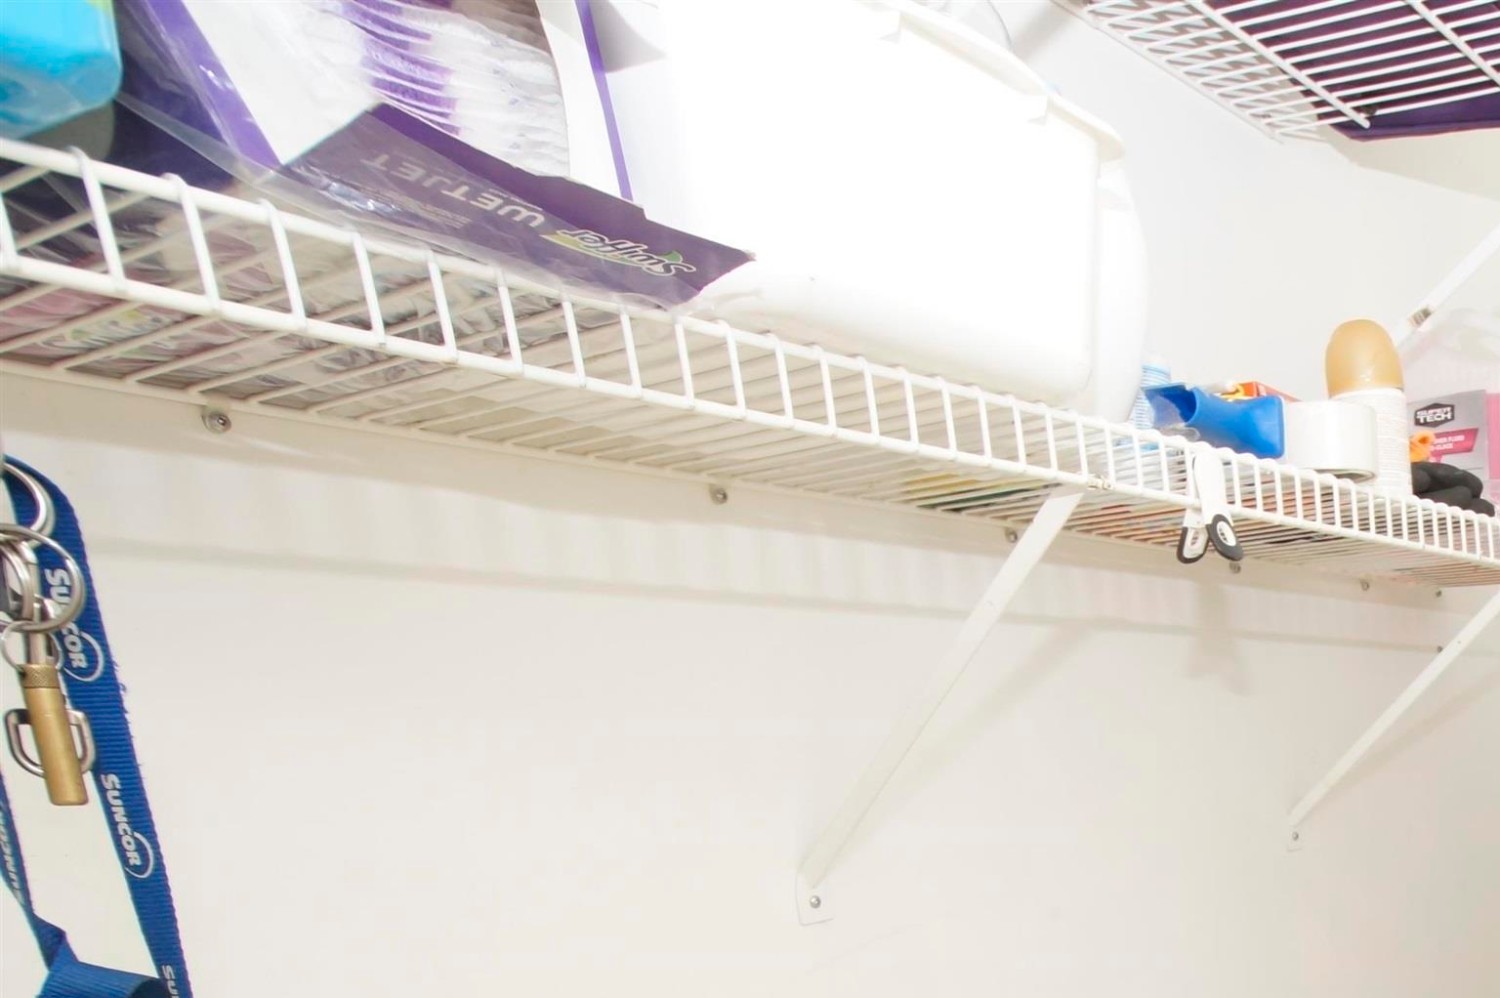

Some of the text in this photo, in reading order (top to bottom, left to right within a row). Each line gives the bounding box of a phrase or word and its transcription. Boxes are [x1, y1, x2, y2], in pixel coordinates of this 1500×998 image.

[364, 153, 546, 228] WETJET
[556, 228, 697, 277] Swiffer
[1416, 406, 1452, 417] SUPER
[1416, 411, 1452, 424] TECH
[44, 568, 88, 669] SUCOR
[100, 773, 142, 867] SUNCOR
